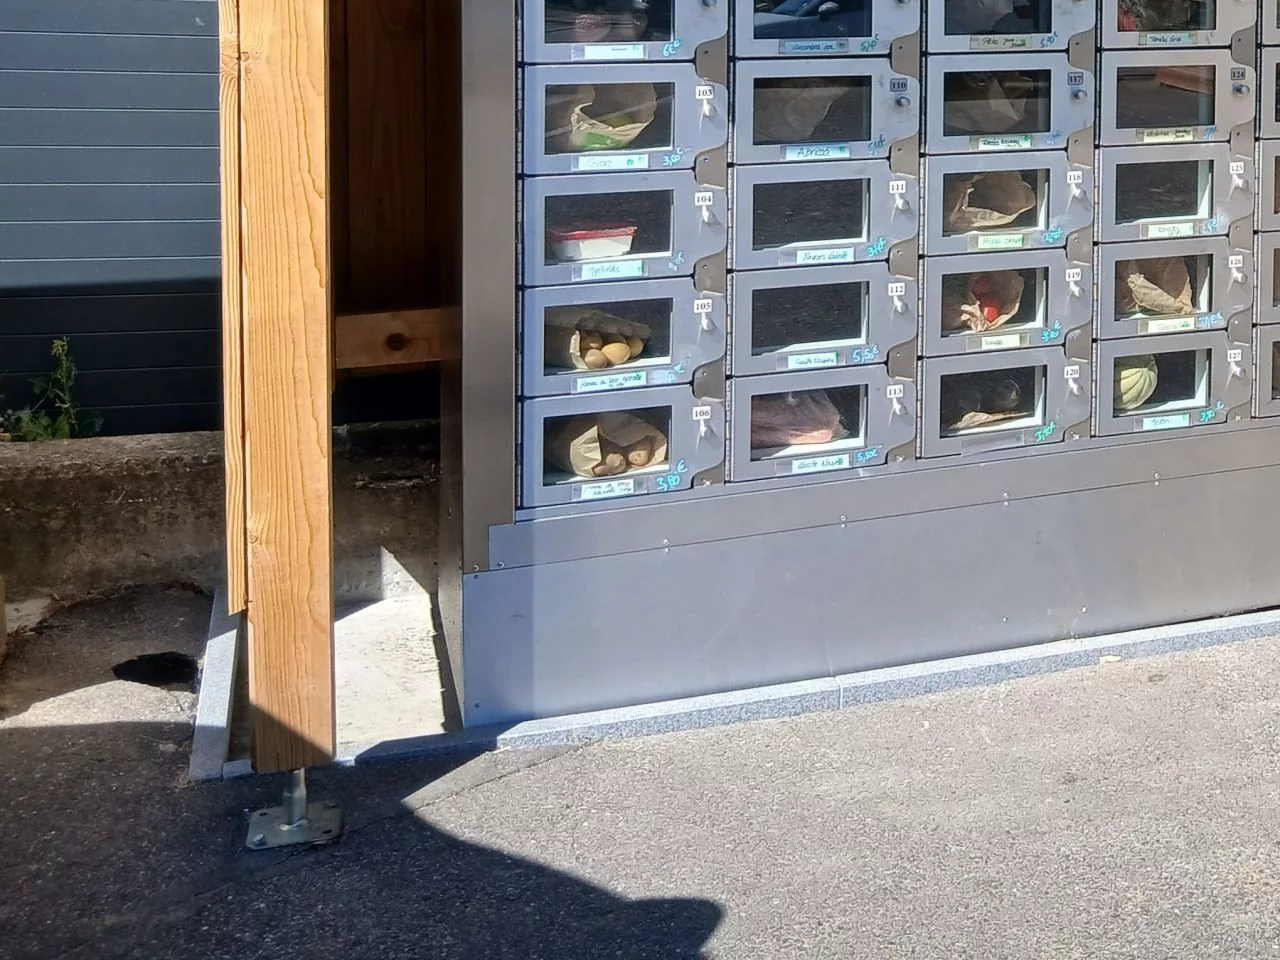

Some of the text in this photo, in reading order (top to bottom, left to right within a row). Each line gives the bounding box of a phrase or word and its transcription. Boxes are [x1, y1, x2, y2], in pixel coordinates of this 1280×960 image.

[1068, 73, 1083, 83] 117
[891, 80, 907, 89] 110
[696, 88, 714, 97] 103
[1230, 163, 1244, 172] 125
[1067, 173, 1082, 182] 118
[889, 183, 906, 192] 111
[695, 195, 712, 204] 104
[1229, 256, 1243, 266] 126
[1066, 270, 1081, 280] 119
[888, 284, 905, 294] 112
[695, 301, 712, 311] 105
[1228, 350, 1241, 360] 127
[1065, 367, 1080, 377] 120
[887, 387, 903, 397] 113
[694, 408, 711, 418] 106
